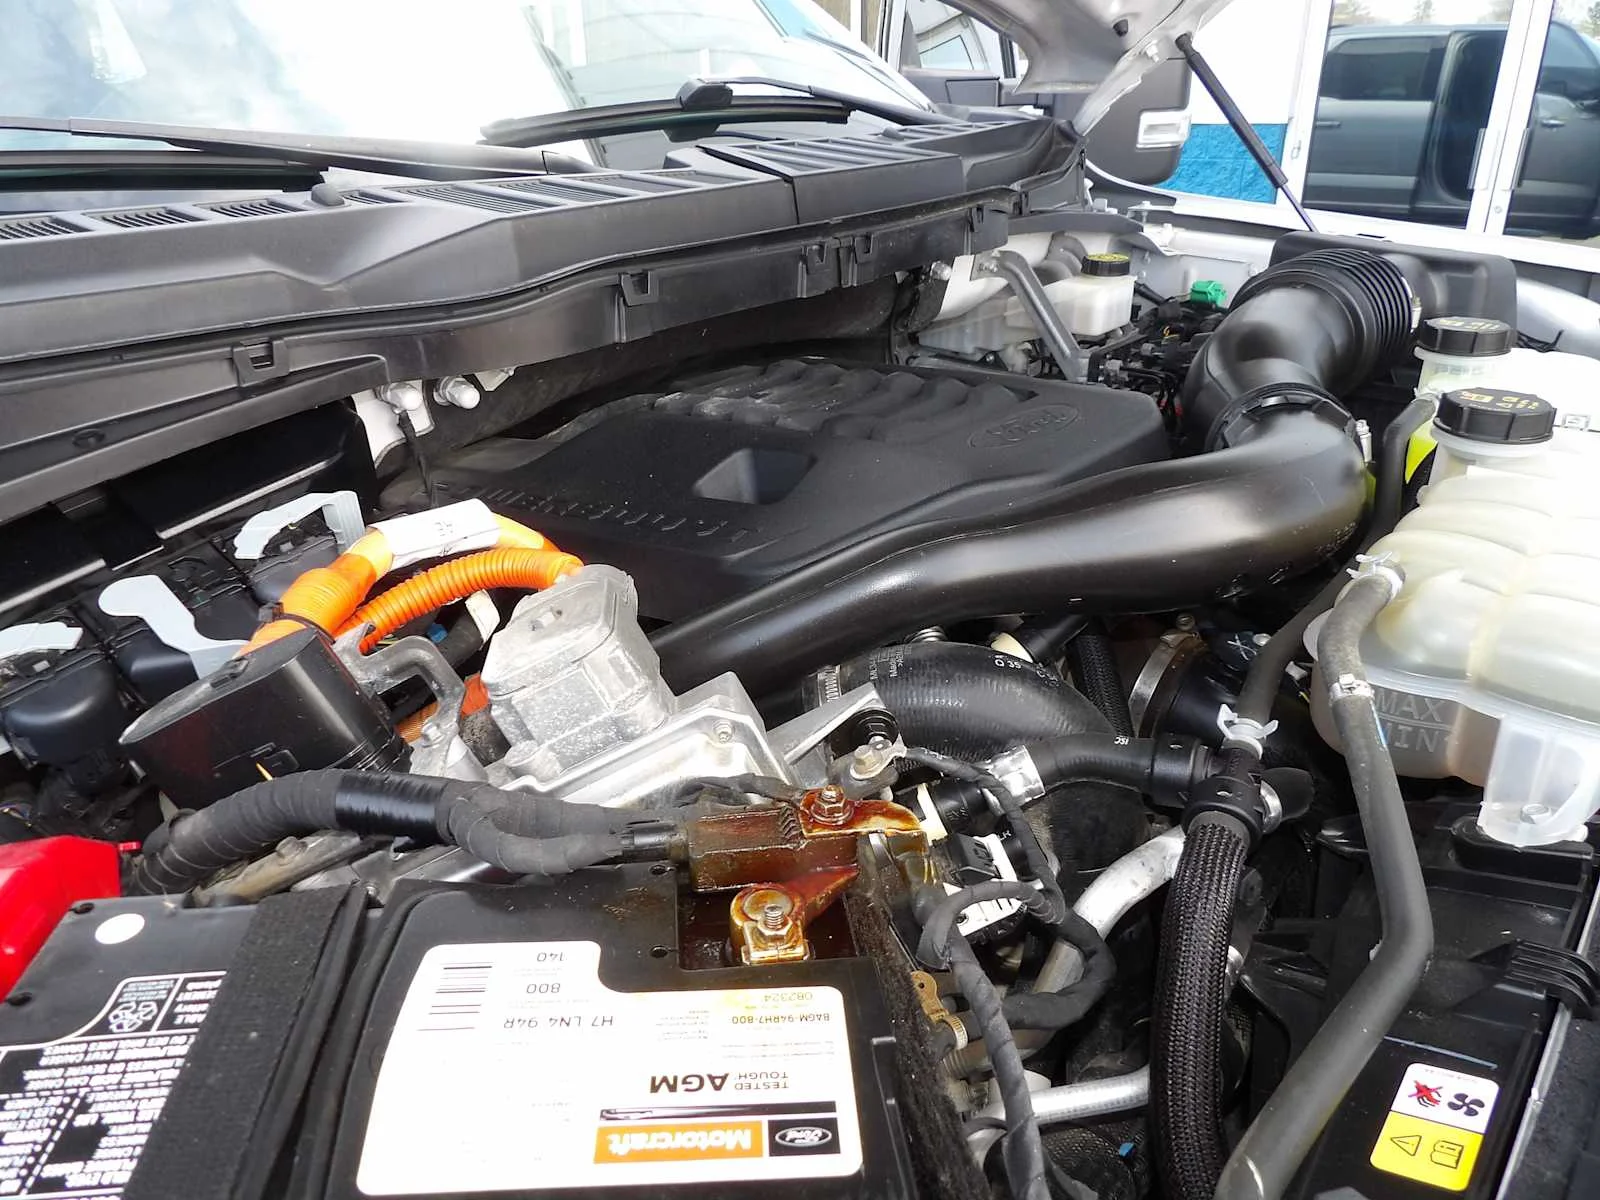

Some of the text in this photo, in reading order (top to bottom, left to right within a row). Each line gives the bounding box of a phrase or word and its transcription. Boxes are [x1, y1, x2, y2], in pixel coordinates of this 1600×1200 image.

[1376, 688, 1445, 722] MAX
[536, 951, 565, 962] 140
[526, 982, 561, 994] 800
[503, 1015, 614, 1029] H7 LN4 94R
[738, 1071, 788, 1081] TOUGH
[649, 1072, 730, 1094] AGM
[734, 1081, 789, 1091] TESTED
[607, 1128, 752, 1156] Motorcraft
